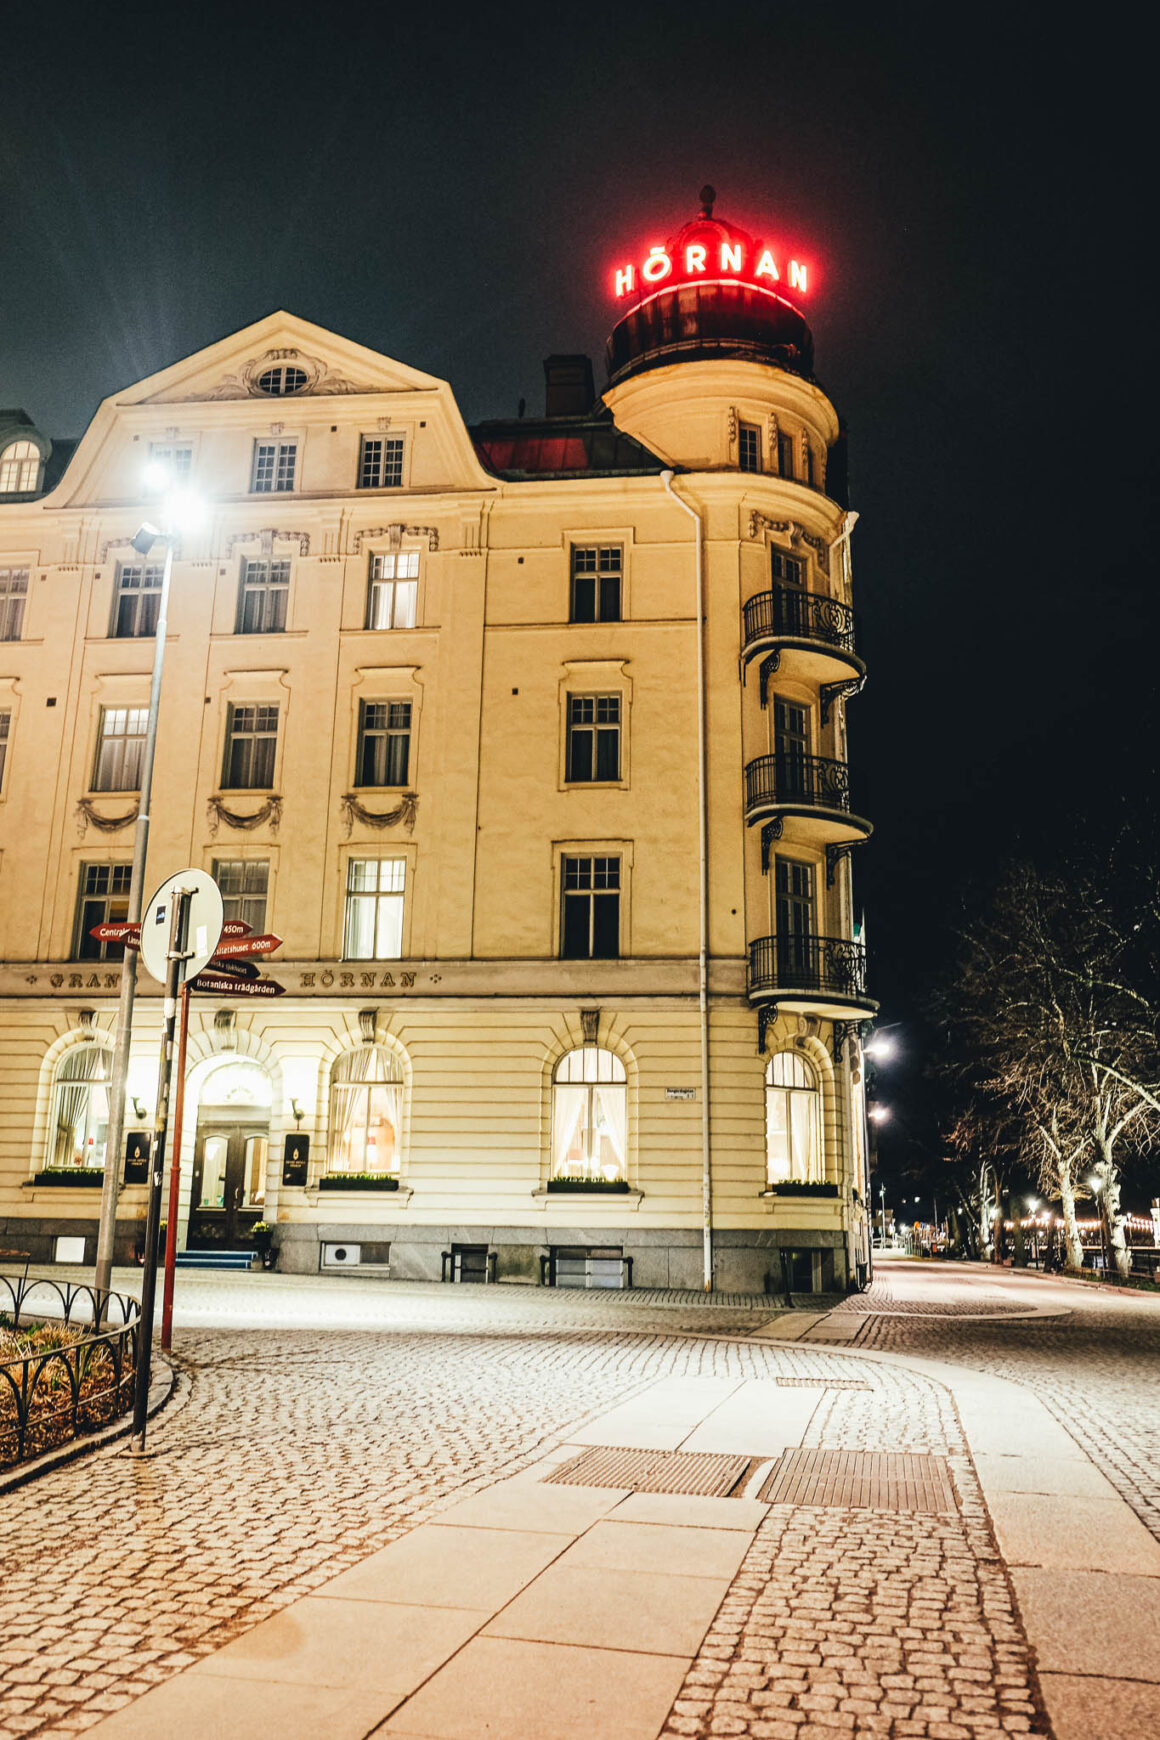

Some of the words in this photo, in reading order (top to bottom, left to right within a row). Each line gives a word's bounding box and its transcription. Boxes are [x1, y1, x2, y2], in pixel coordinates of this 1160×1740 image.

[223, 924, 244, 934] 450m
[251, 940, 271, 950] 600m
[49, 973, 139, 988] GRAN
[300, 970, 417, 988] HÖRNAN
[196, 978, 233, 990] Botaniska
[234, 982, 276, 995] trädgården
